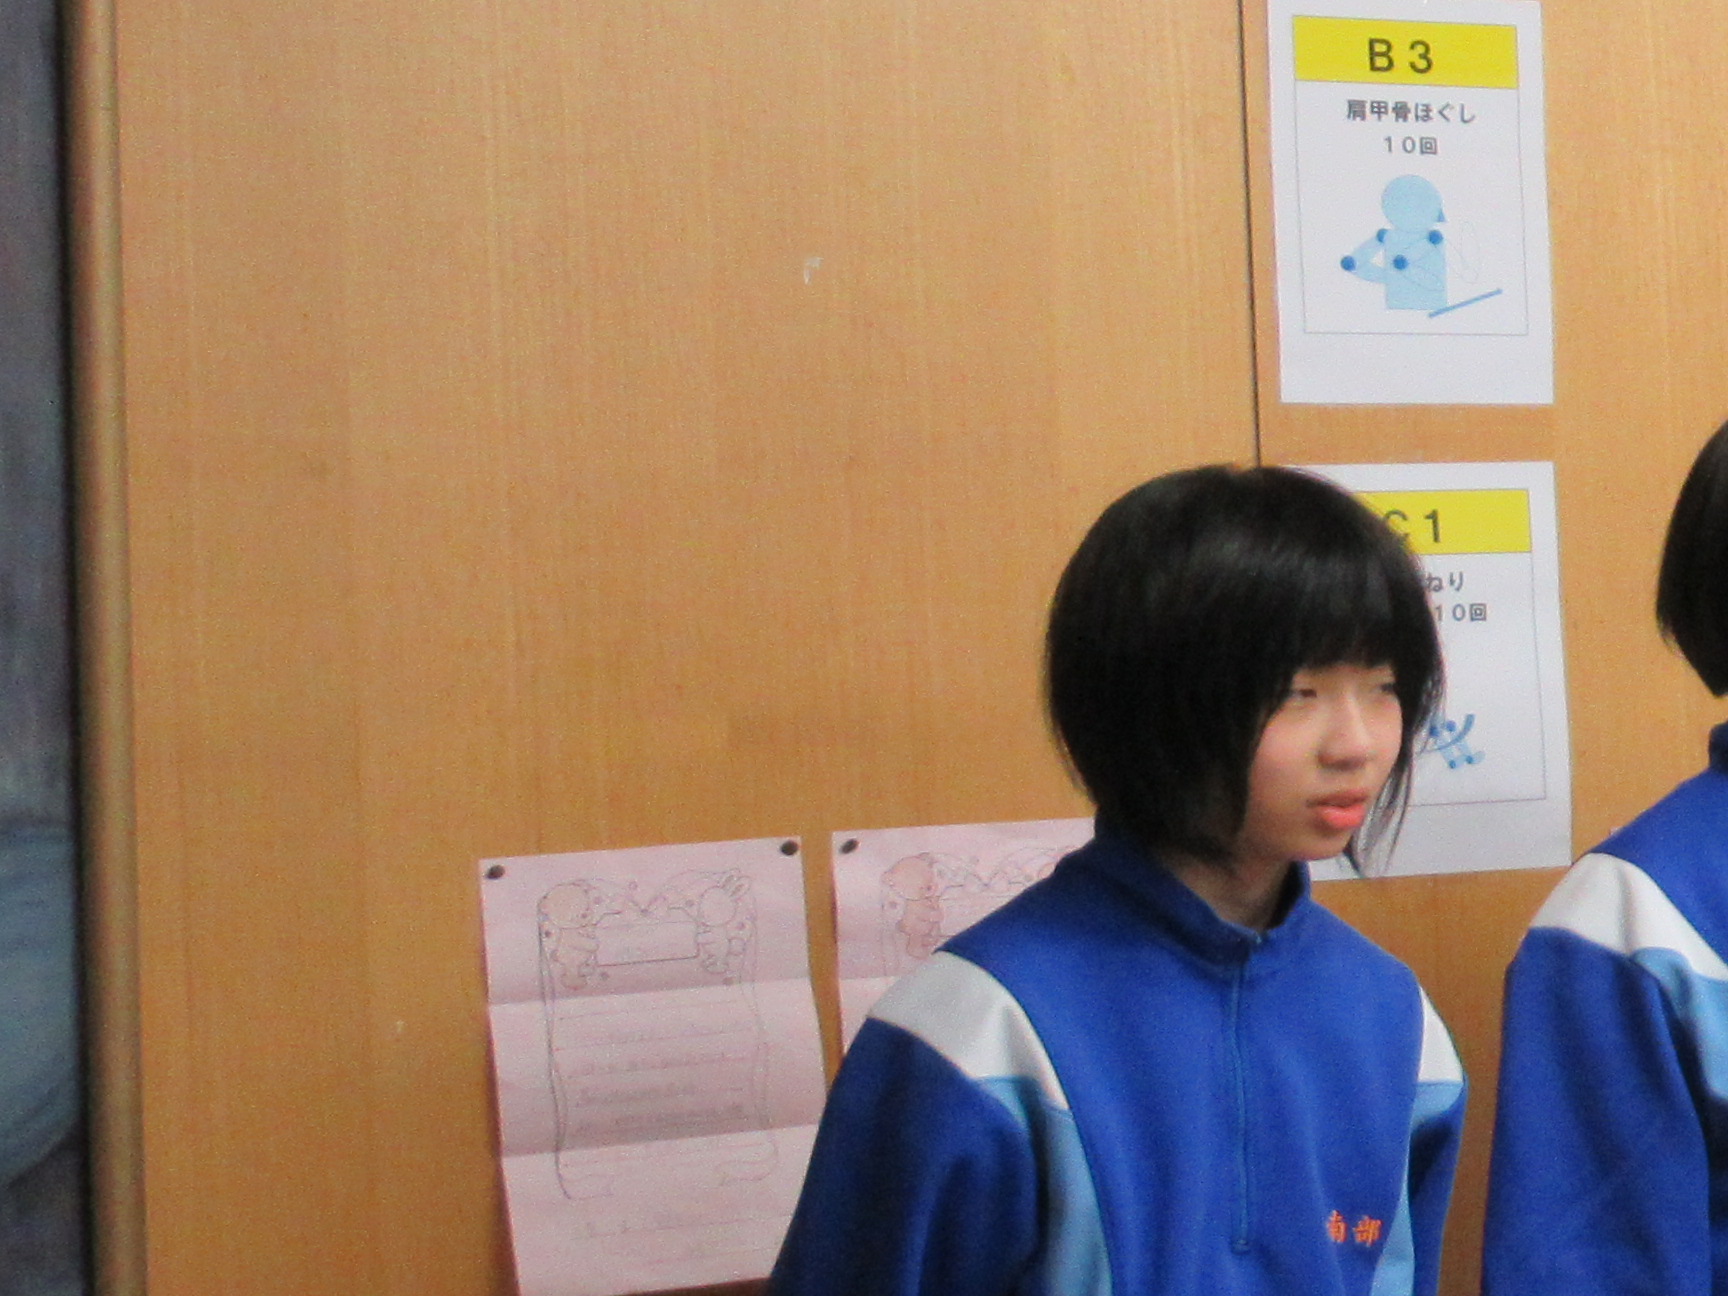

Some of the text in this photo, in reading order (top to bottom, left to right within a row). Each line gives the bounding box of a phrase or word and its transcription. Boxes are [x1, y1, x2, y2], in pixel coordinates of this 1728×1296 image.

[1368, 38, 1434, 74] B3
[1347, 99, 1476, 124] 肩甲骨ほぐし
[1385, 136, 1438, 156] 10回
